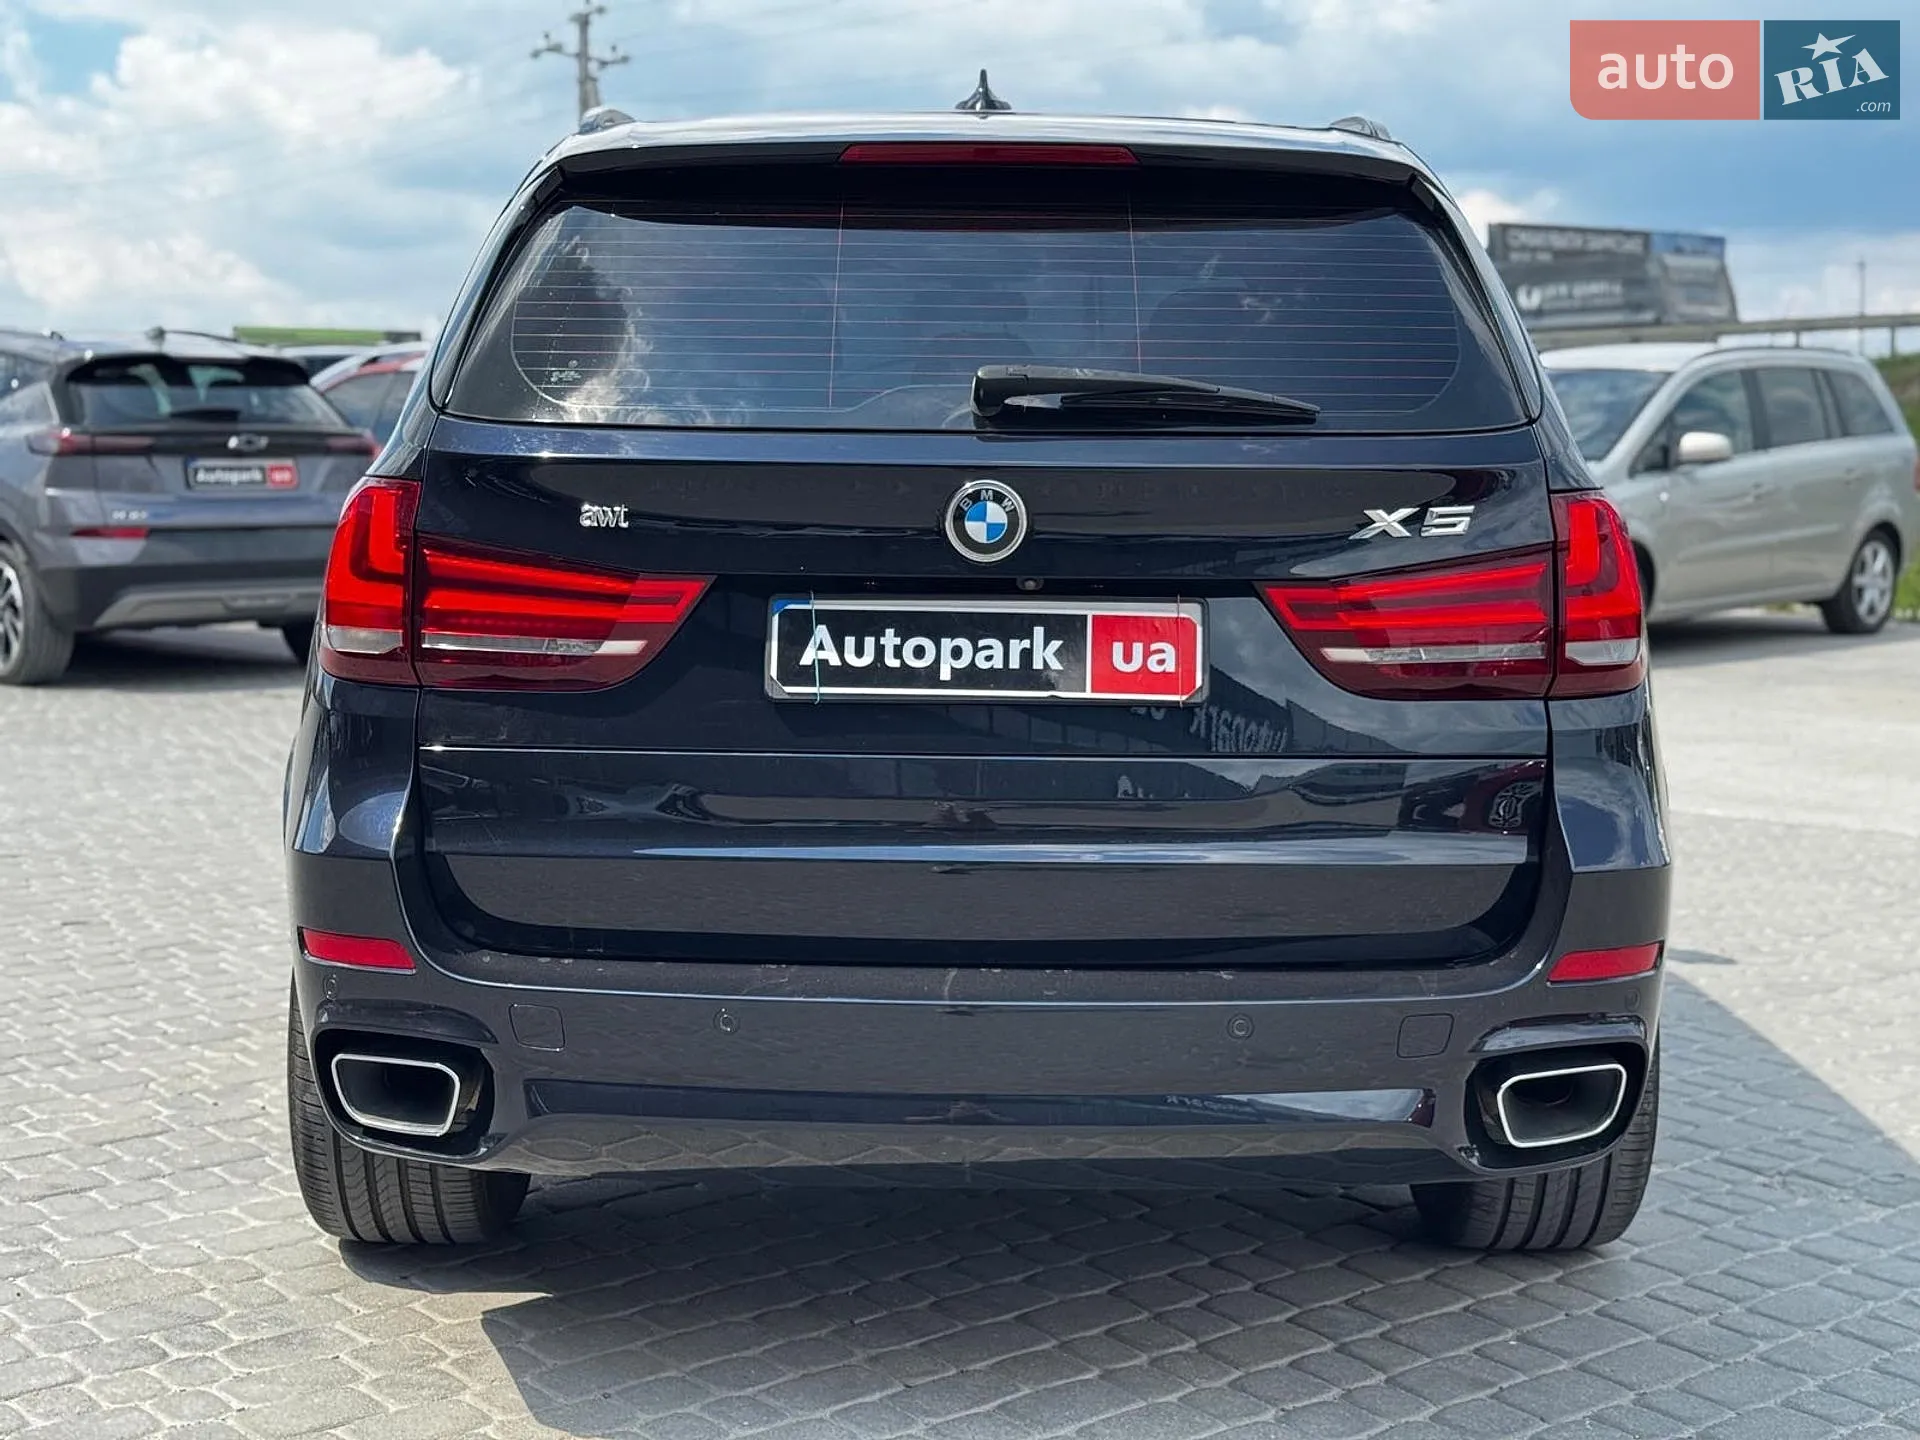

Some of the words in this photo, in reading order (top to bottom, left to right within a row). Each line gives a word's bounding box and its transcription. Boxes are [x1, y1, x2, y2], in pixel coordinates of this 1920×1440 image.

[959, 489, 1015, 512] BMW
[1348, 505, 1476, 541] X5
[799, 624, 1065, 682] Autopark
[1111, 638, 1177, 674] ua
